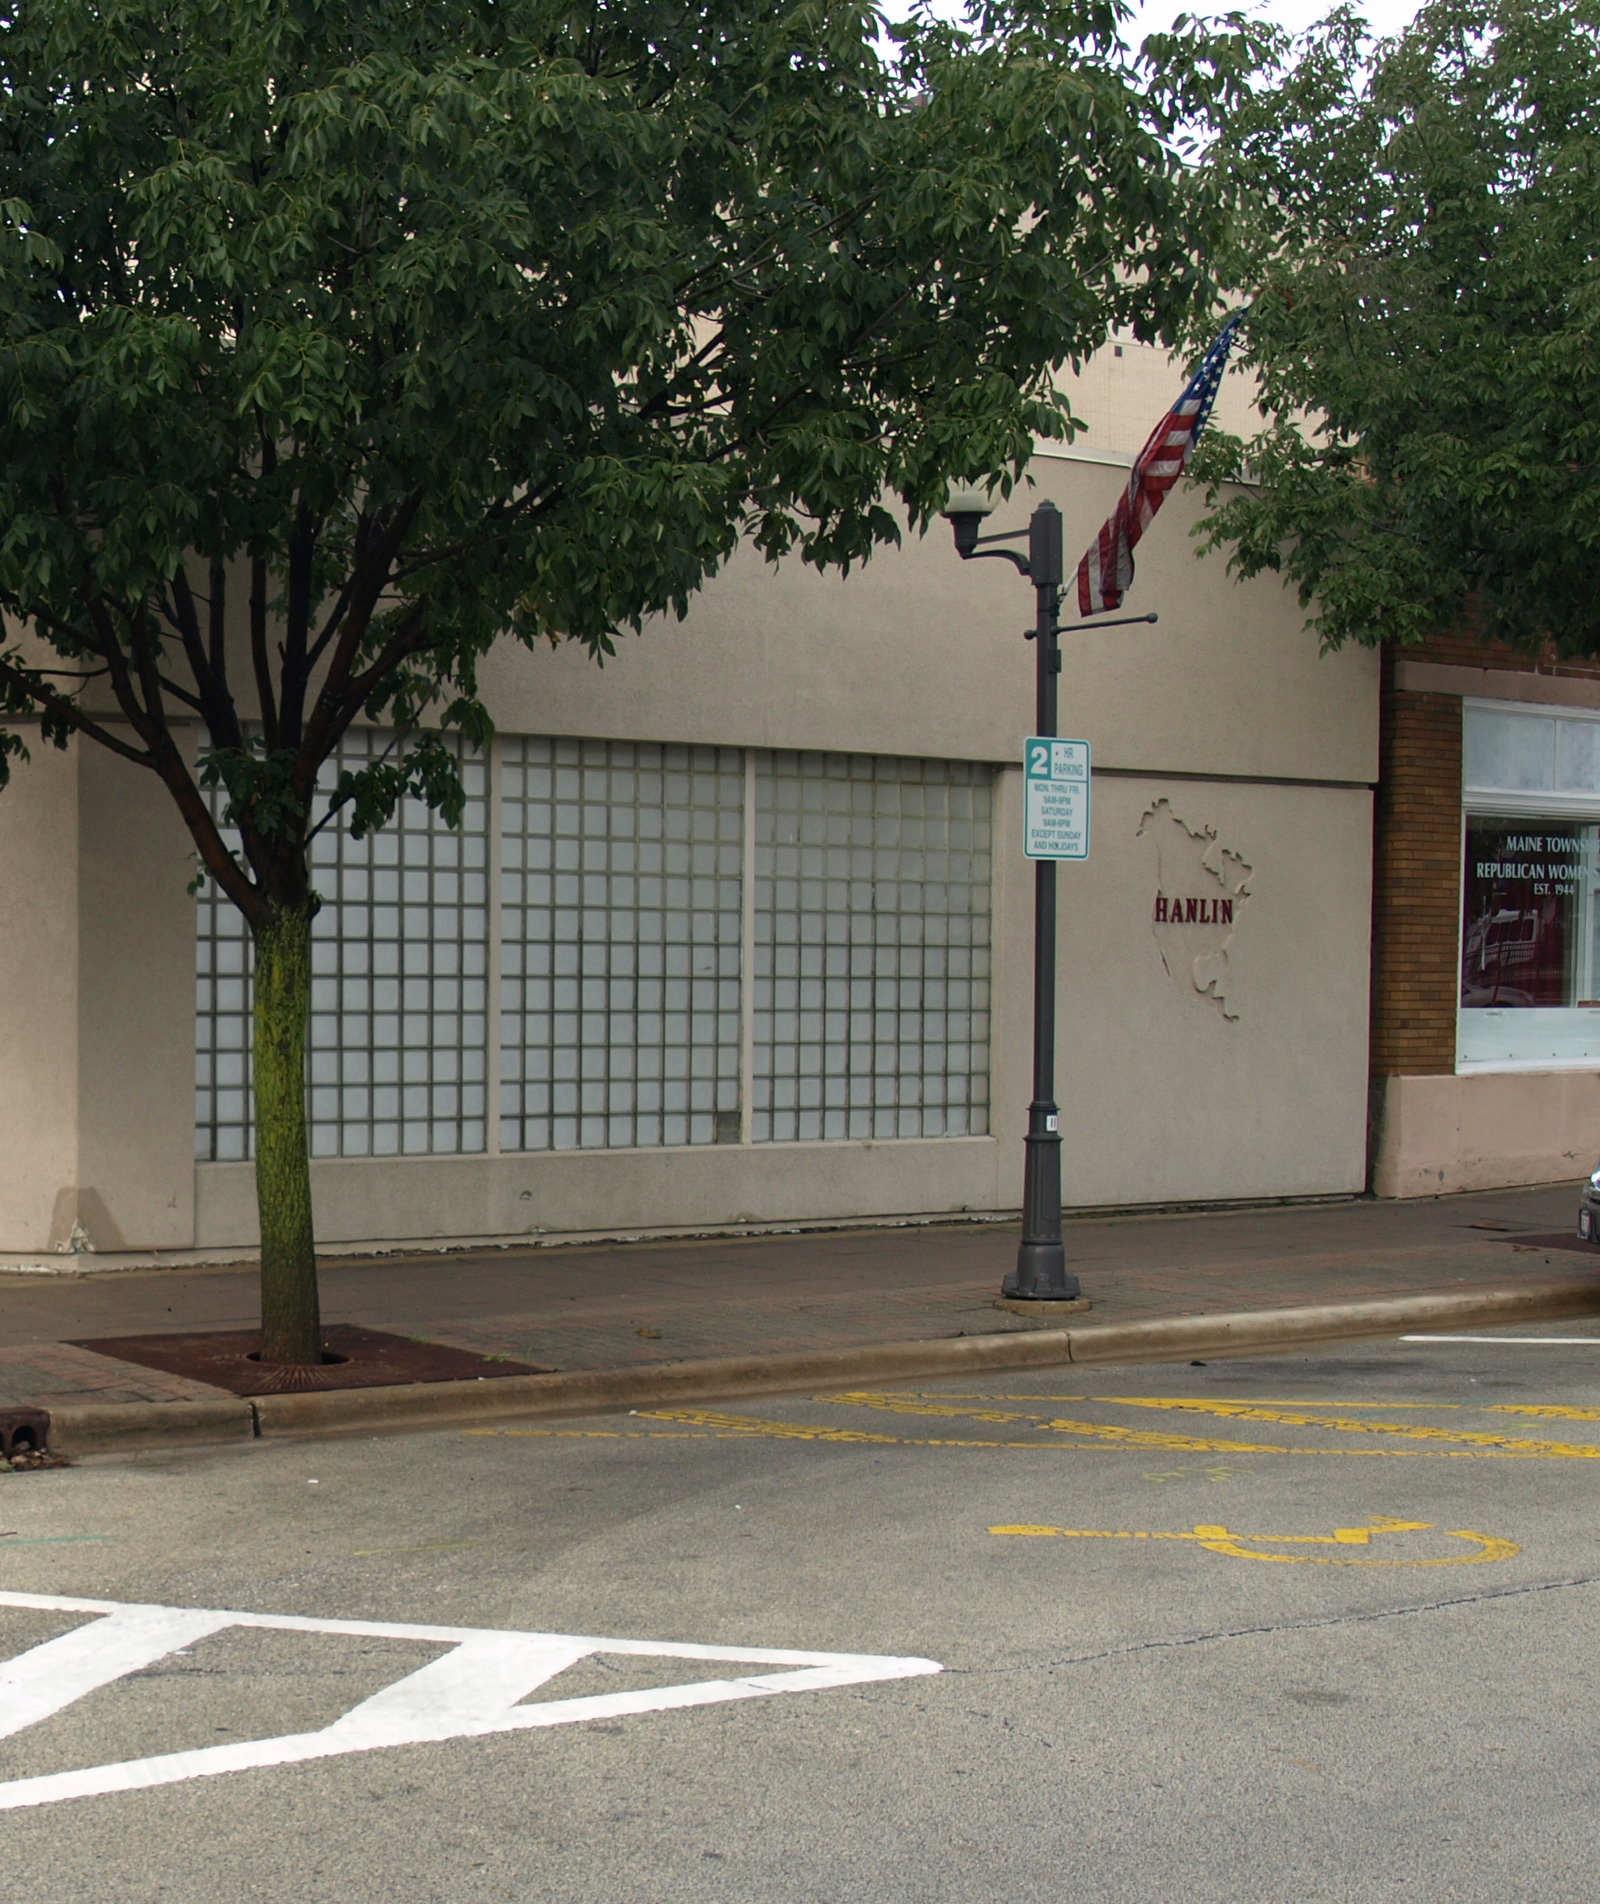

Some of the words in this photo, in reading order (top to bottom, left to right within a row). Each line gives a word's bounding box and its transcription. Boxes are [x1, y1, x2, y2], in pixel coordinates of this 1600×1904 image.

[1031, 746, 1048, 775] 2
[1054, 762, 1083, 776] PARKING
[1050, 784, 1068, 794] THRU
[1041, 806, 1073, 817] SATURDAY
[1031, 829, 1055, 838] EXCEPT
[1056, 831, 1081, 840] SUNDAY
[1034, 840, 1048, 850] AND
[1506, 835, 1543, 852] MAINE
[1477, 862, 1545, 879] REPUBLICAN
[1155, 898, 1233, 924] HANLIN
